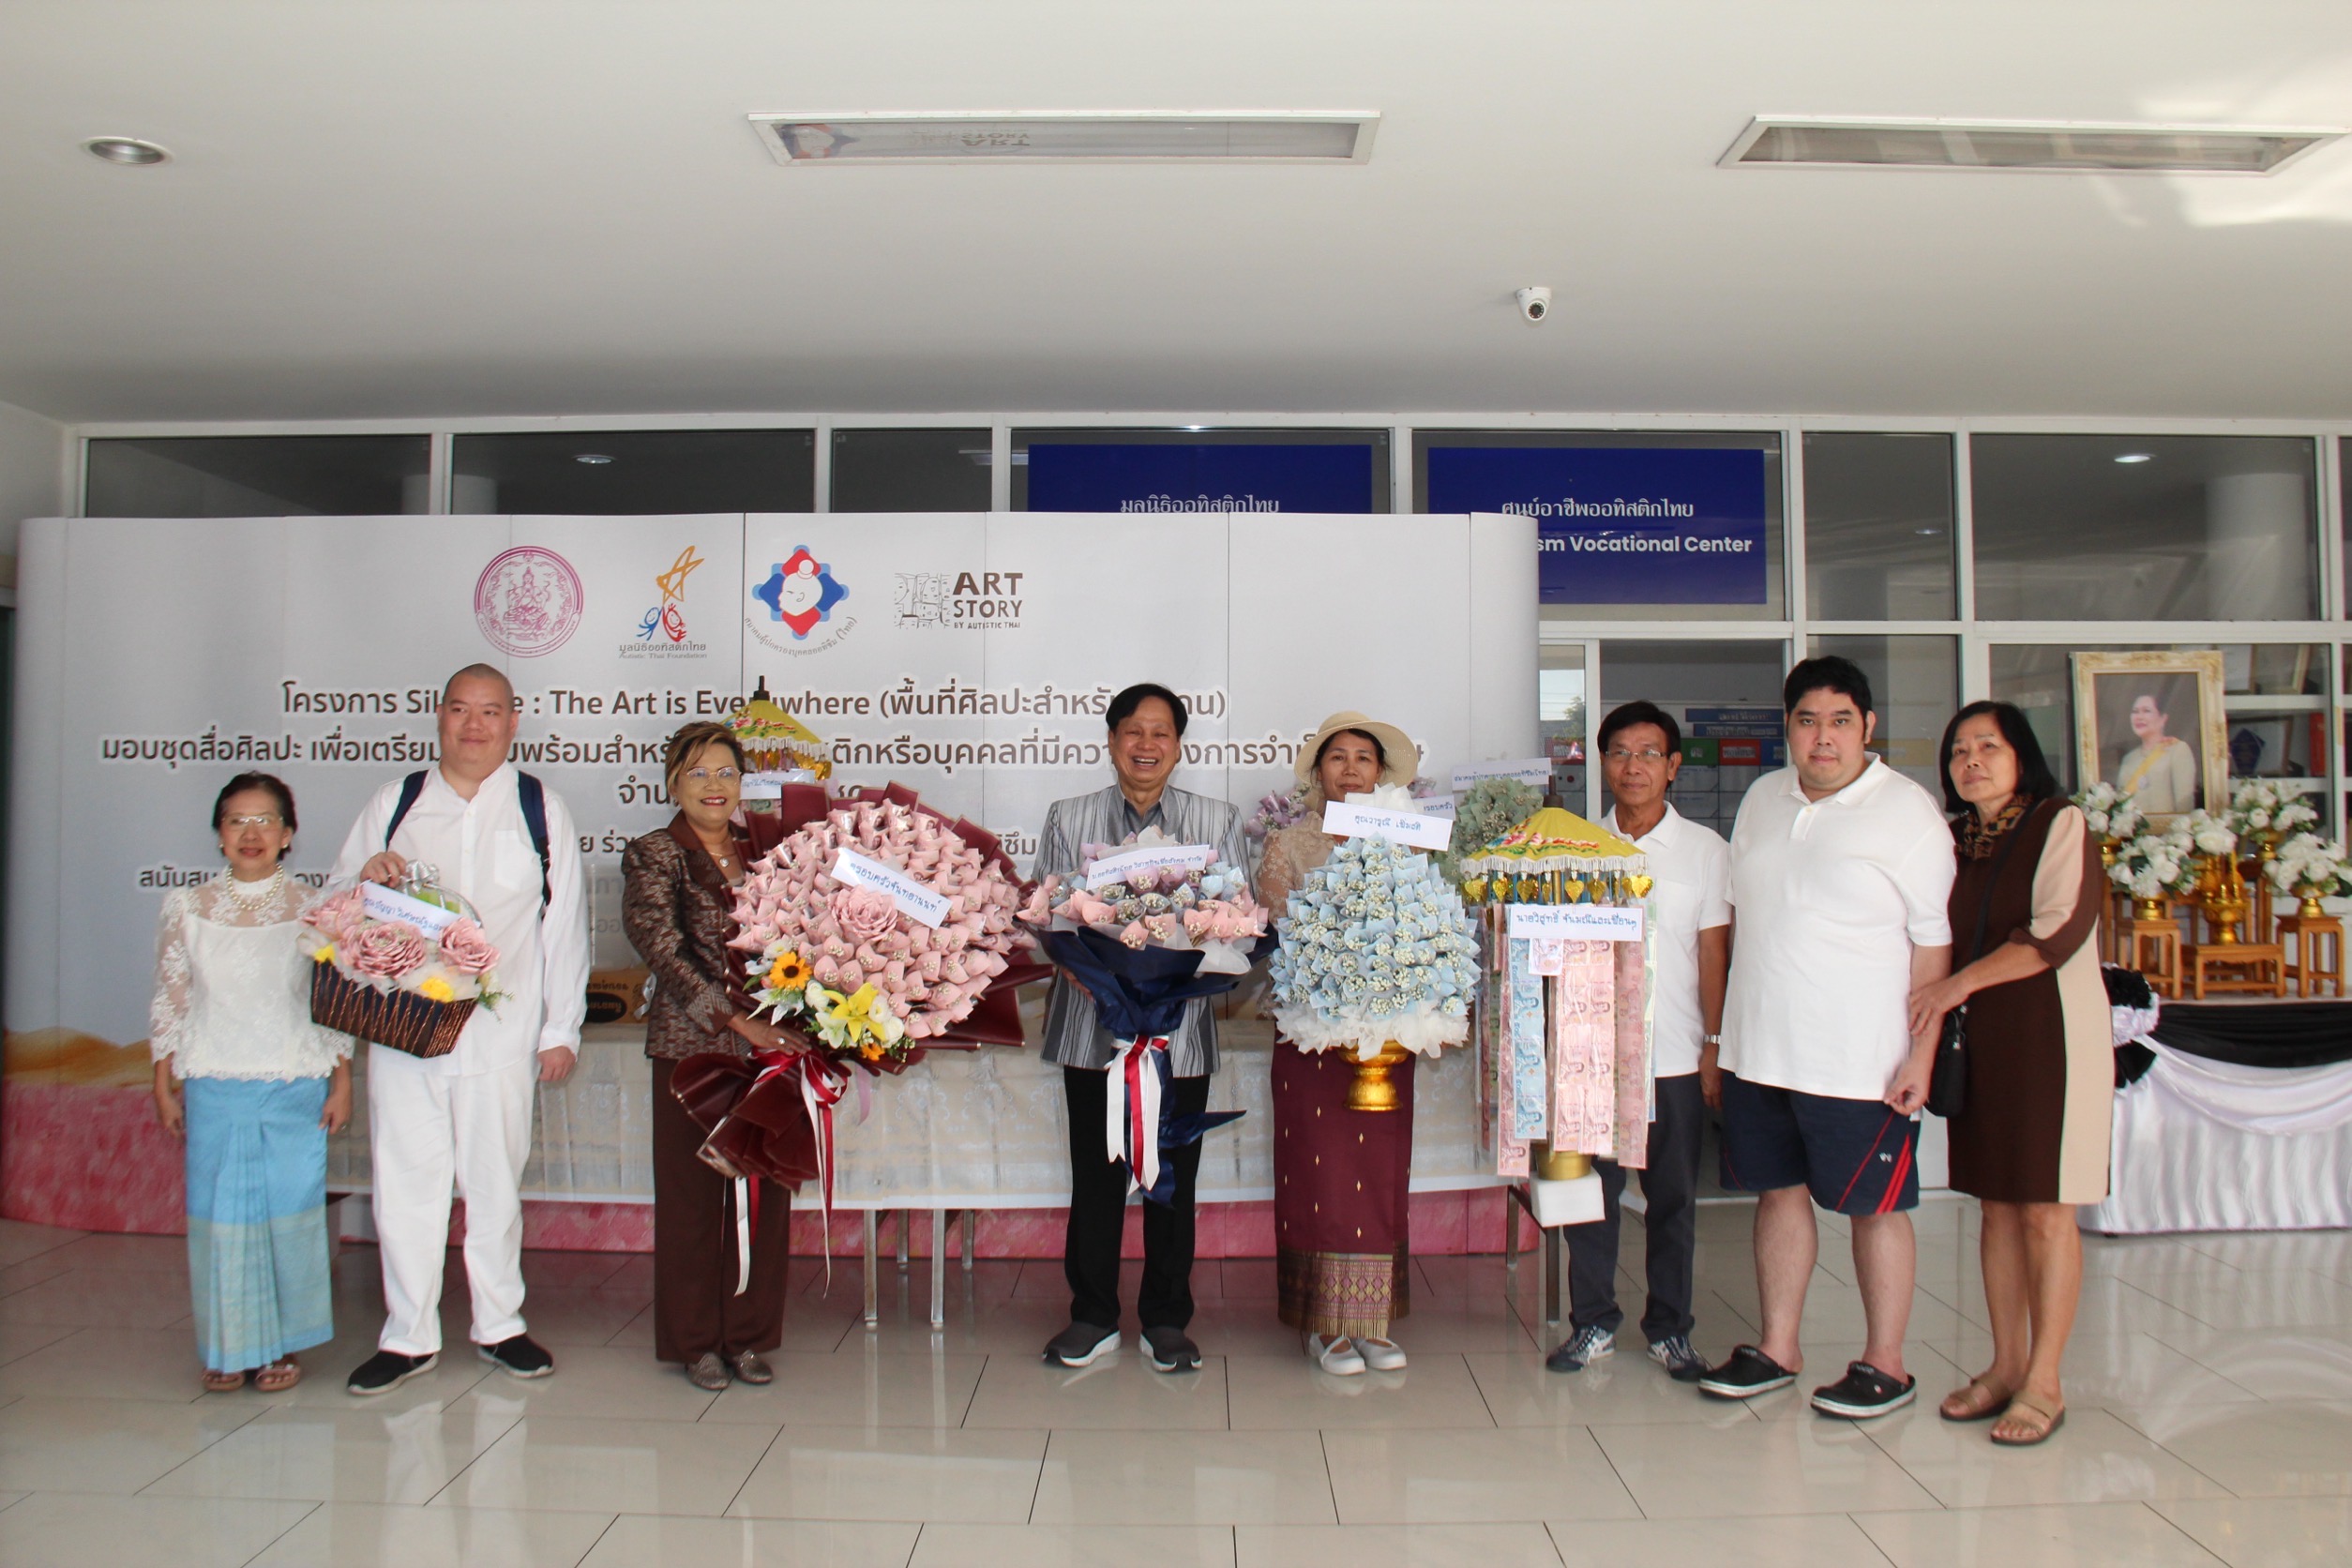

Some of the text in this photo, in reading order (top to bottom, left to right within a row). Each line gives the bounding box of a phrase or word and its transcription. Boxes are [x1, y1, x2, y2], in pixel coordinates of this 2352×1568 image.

[1121, 494, 1279, 512] มลนิธิออทิสติกไทย
[1501, 497, 1694, 517] ศนย์อาชีพออทิสติกไทย
[1572, 535, 1680, 552] Vocational
[1684, 536, 1753, 552] Center
[952, 572, 1023, 596] ART
[953, 599, 1023, 619] STORY
[967, 622, 1002, 630] AUTISTIC
[1004, 621, 1020, 629] THAI
[283, 680, 398, 714] โครงการ
[550, 689, 603, 715] The
[611, 689, 656, 715] Art
[666, 689, 686, 715] is
[696, 689, 870, 716] Evewhere
[102, 725, 302, 769] มอบชุดสื่อศิลปะ
